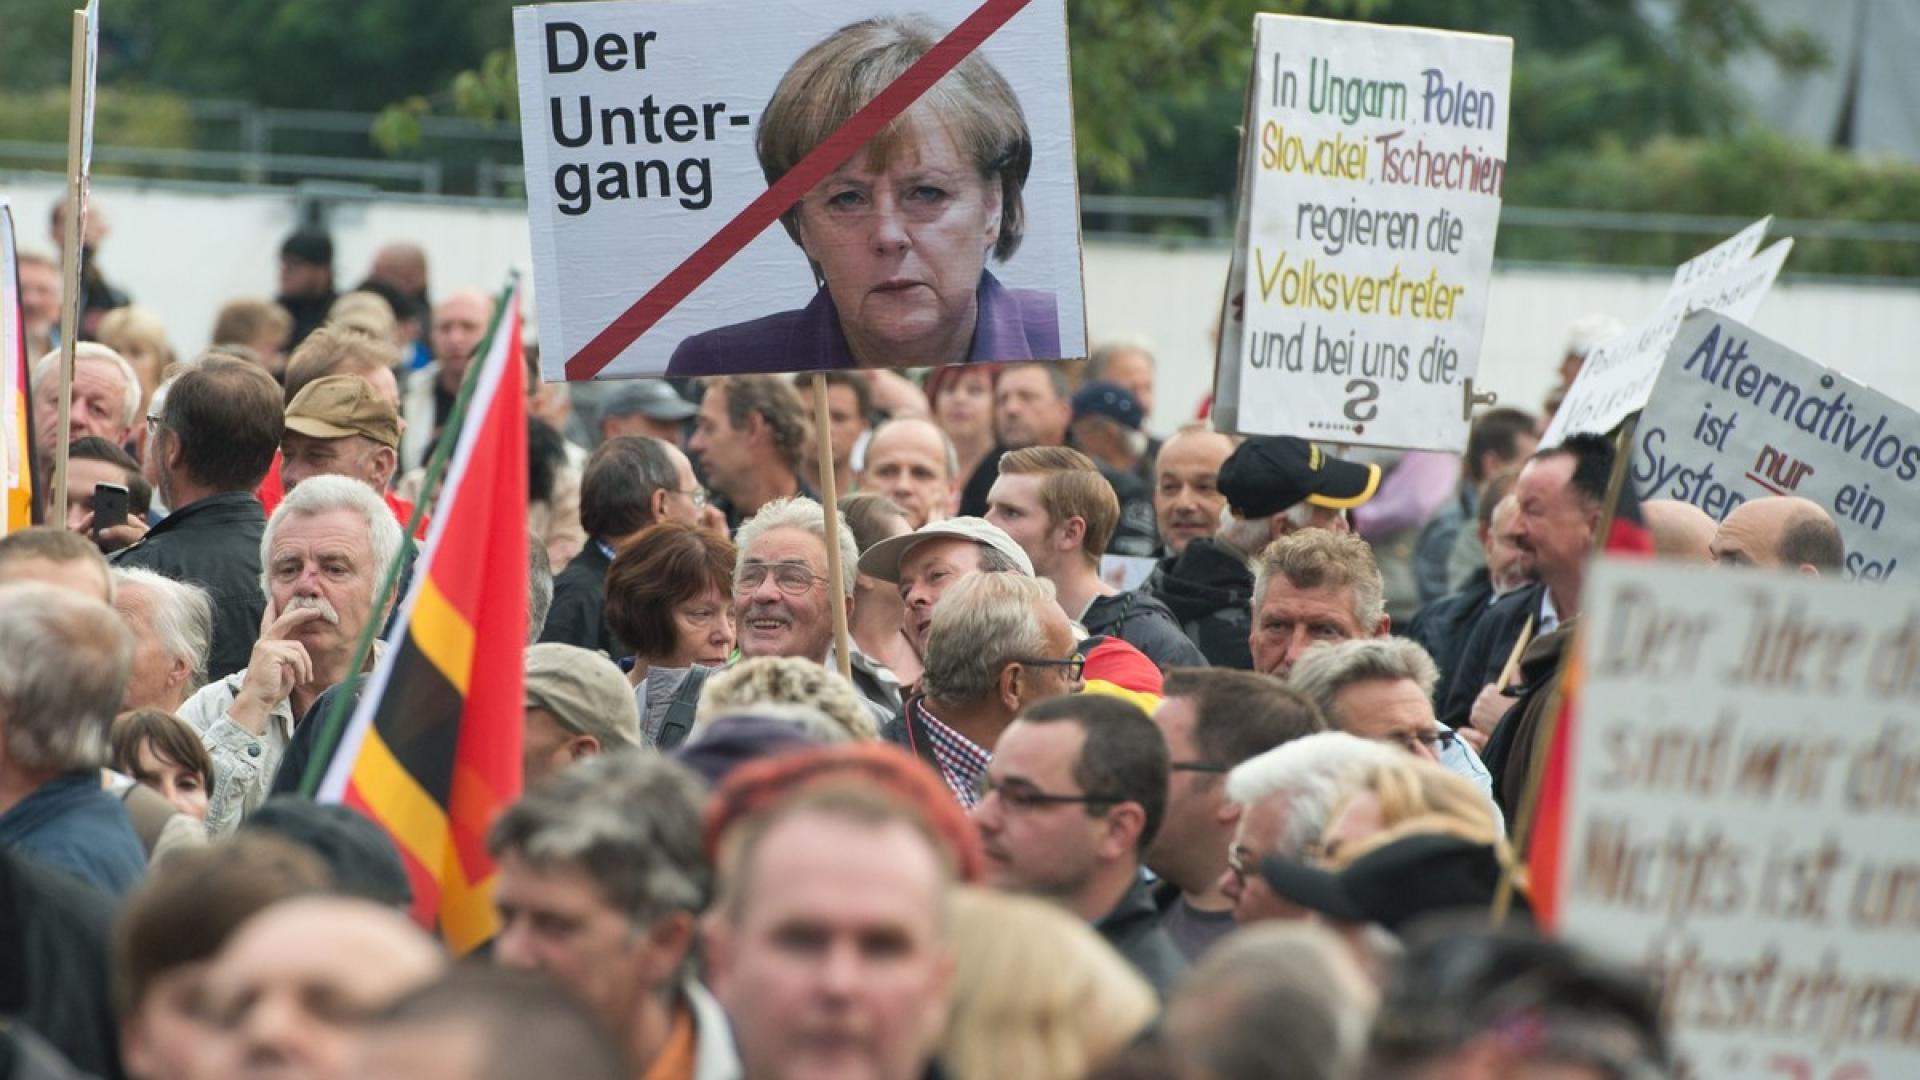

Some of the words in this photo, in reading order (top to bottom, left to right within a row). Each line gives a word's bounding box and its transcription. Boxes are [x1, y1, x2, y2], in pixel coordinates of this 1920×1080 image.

[545, 21, 657, 74] Der
[550, 94, 750, 148] Unter-
[1272, 52, 1297, 109] In
[1421, 68, 1495, 131] Polen
[554, 157, 713, 216] gang
[1376, 130, 1506, 199] Tschechien
[1296, 197, 1420, 256] regieren
[1426, 207, 1464, 255] die
[1255, 247, 1464, 321] Volksvertreter
[1250, 321, 1306, 373] und
[1313, 325, 1355, 376] bei
[1362, 340, 1410, 382] uns
[1684, 322, 1920, 482] Alternativlos
[1692, 403, 1737, 453] ist
[1753, 443, 1815, 492] nur
[1834, 481, 1887, 531] ein
